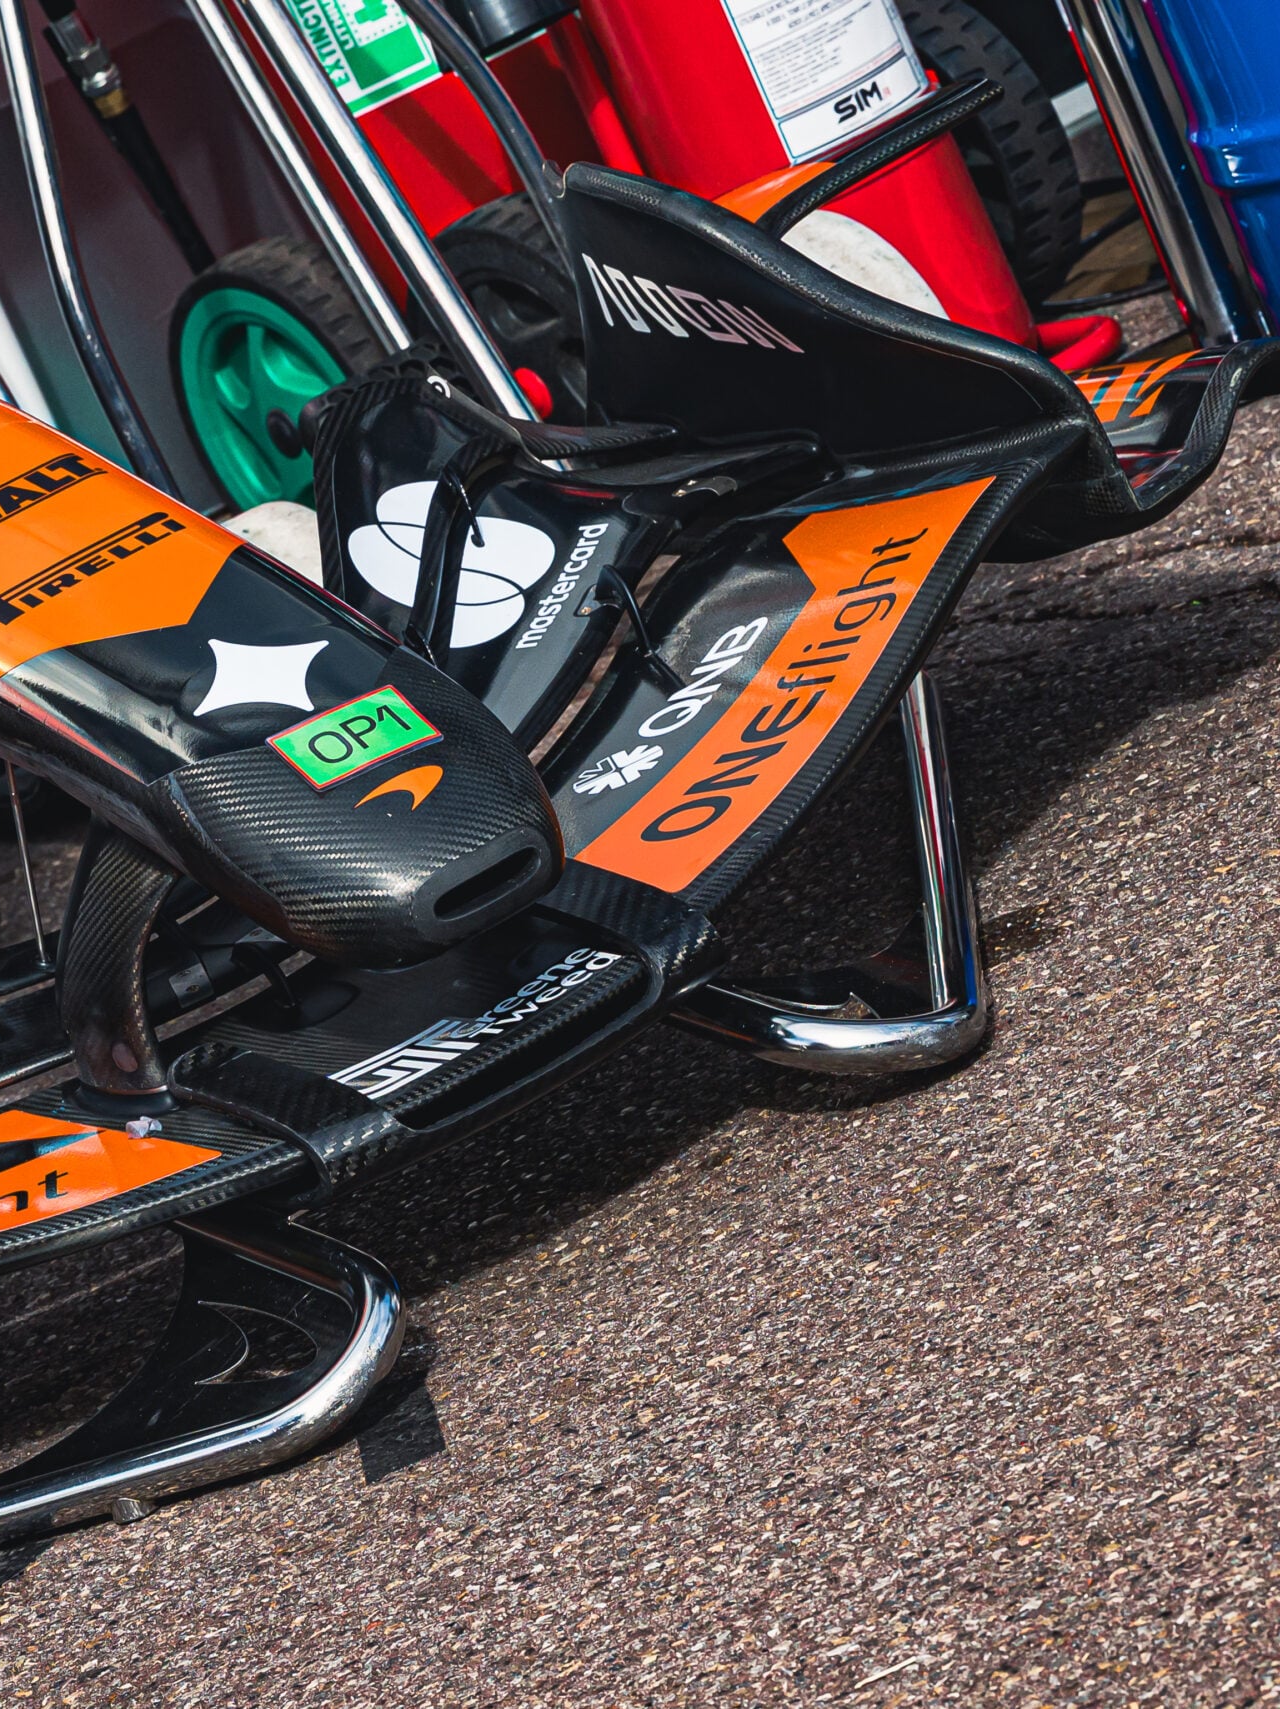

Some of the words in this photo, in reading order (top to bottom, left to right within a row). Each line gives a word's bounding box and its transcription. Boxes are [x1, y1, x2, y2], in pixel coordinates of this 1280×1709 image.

[833, 81, 883, 124] SIM
[515, 522, 609, 650] mastercard
[638, 615, 768, 739] QNB
[639, 526, 929, 842] ONEflight
[308, 704, 412, 764] OP1
[469, 950, 622, 1038] Tweed
